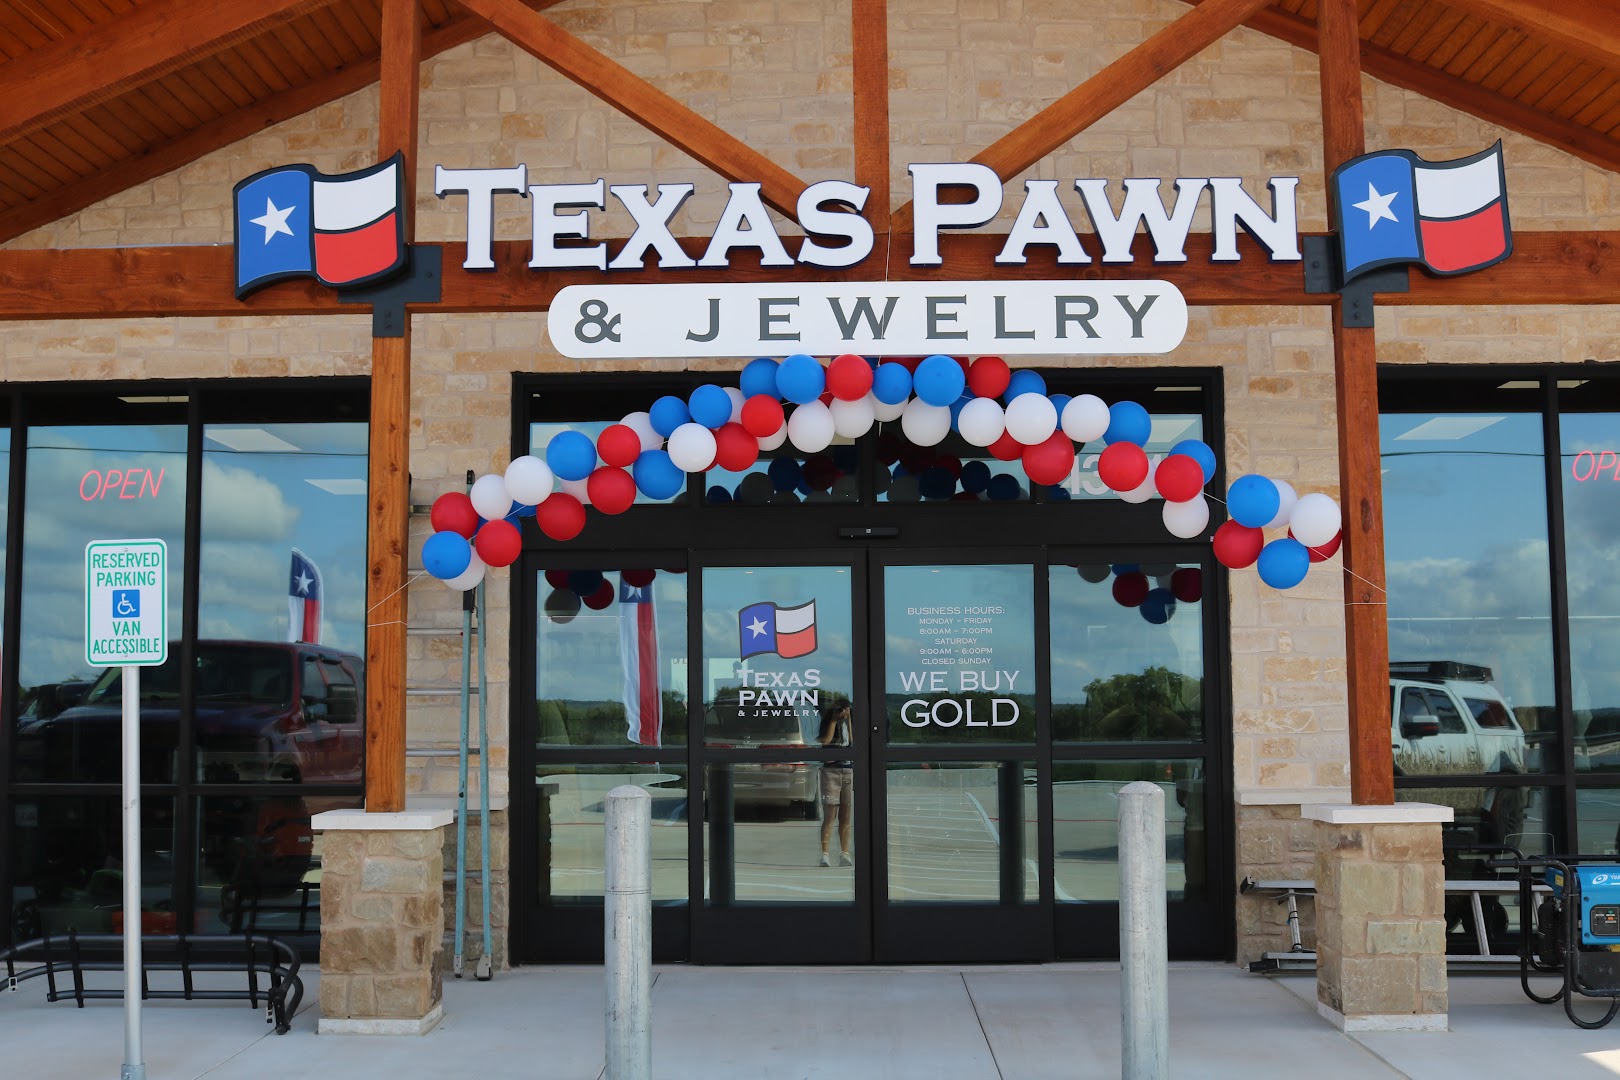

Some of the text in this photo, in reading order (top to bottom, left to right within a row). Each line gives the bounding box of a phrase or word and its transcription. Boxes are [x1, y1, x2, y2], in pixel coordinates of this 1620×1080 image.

[434, 162, 1303, 273] TEXAS PAWN
[574, 294, 1160, 344] & JEWELRY
[79, 468, 165, 501] OPEN
[92, 552, 160, 569] RESERVED
[96, 571, 156, 587] PARKING
[907, 606, 1006, 615] BUSINESS HOURS:
[112, 621, 141, 636] VAN
[92, 638, 160, 655] ACCESSIBLE
[736, 668, 821, 688] TEXAS
[899, 670, 1020, 691] WE BUY
[738, 689, 819, 707] PAWN
[753, 709, 820, 717] JEWELRY
[900, 698, 1020, 728] GOLD
